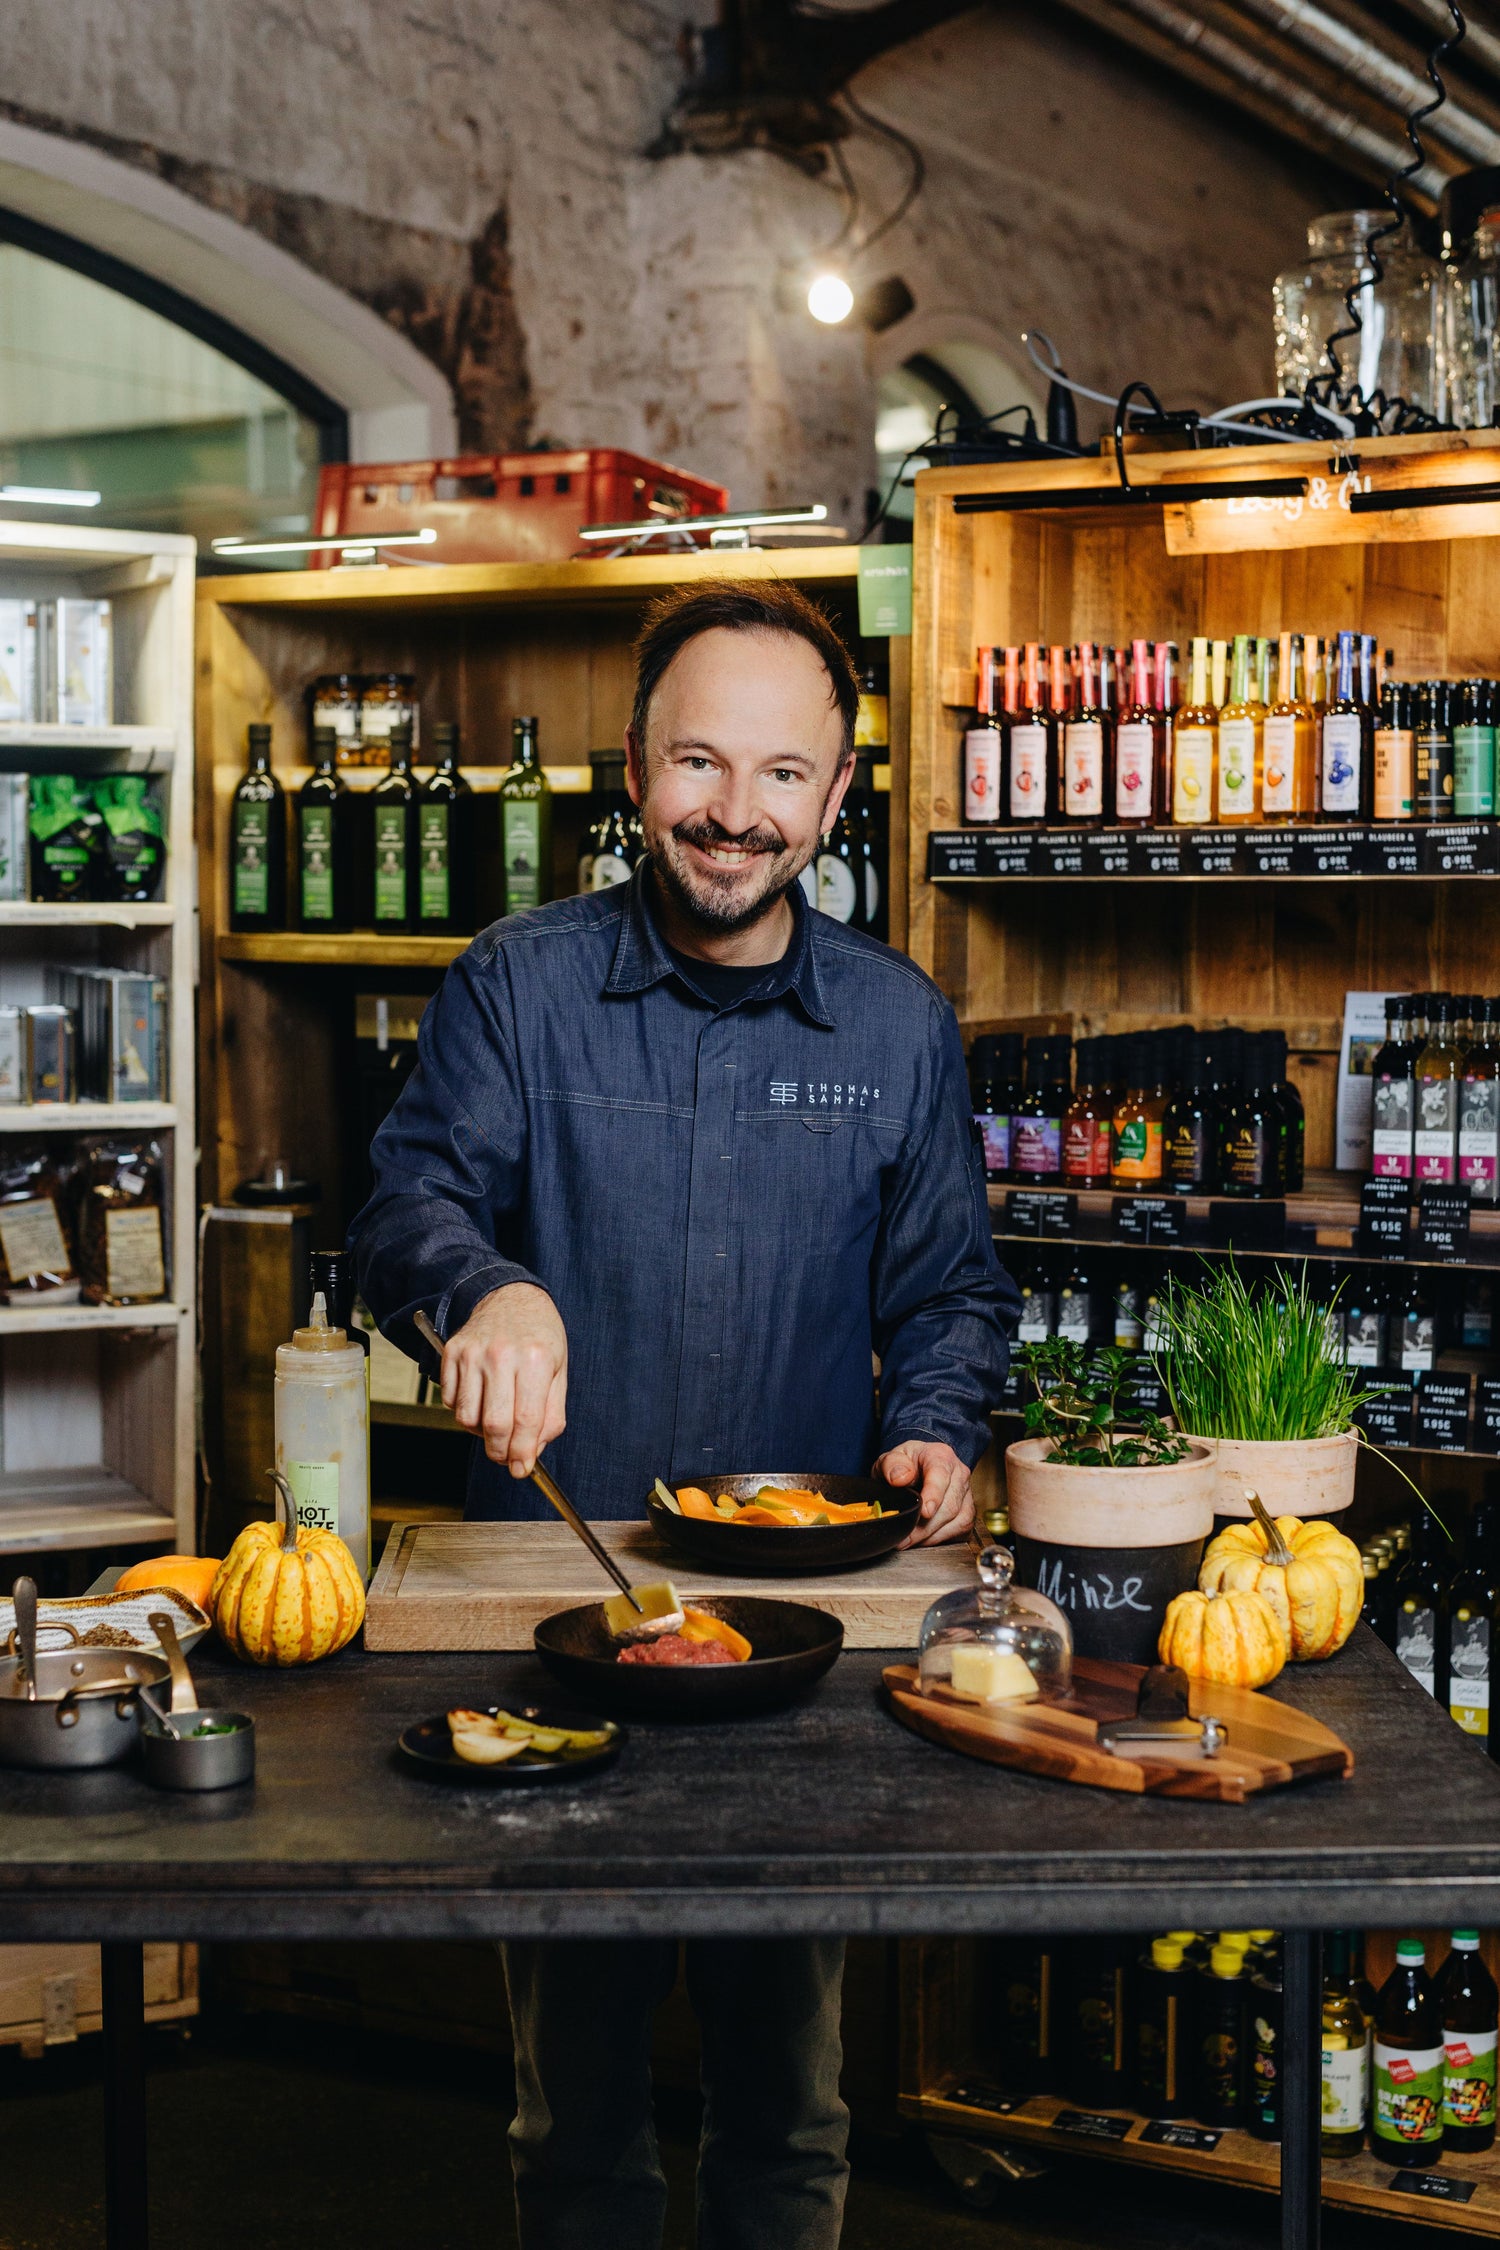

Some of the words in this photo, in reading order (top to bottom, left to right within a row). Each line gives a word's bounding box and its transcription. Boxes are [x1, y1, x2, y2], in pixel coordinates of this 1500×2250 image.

[1310, 477, 1332, 510] &
[807, 1083, 880, 1099] THOMAS
[808, 1094, 866, 1107] SAMPL
[297, 1506, 331, 1521] HOT
[1036, 1556, 1153, 1612] Minze
[1377, 2088, 1409, 2108] BRAT
